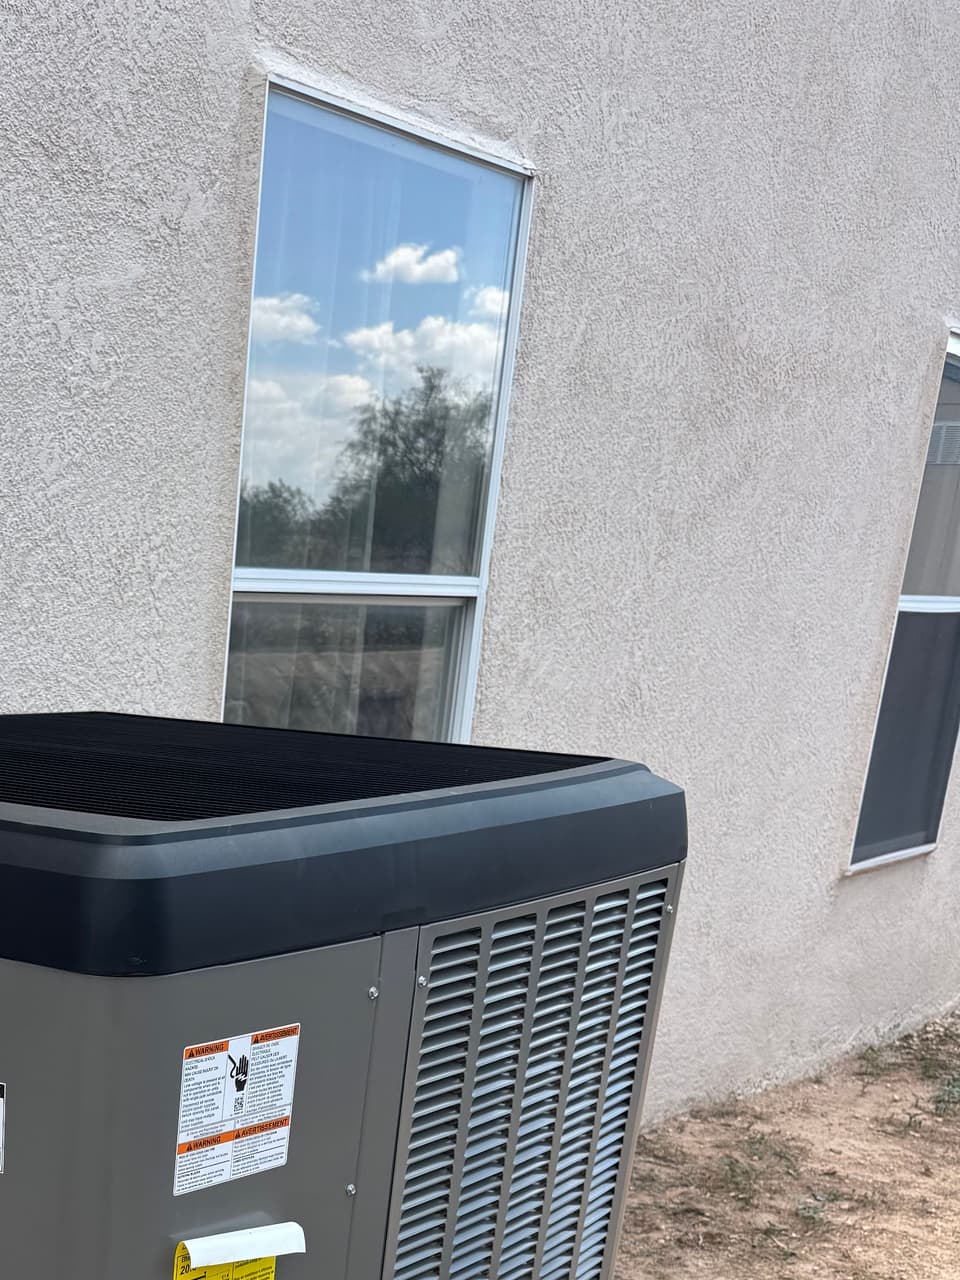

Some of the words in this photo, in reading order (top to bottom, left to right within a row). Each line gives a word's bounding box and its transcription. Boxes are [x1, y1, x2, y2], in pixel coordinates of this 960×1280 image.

[260, 1028, 297, 1041] AVERTISSEMENT
[195, 1043, 224, 1055] WARNING
[241, 1118, 287, 1136] AVERTISSEMENT
[193, 1136, 221, 1149] WARNING
